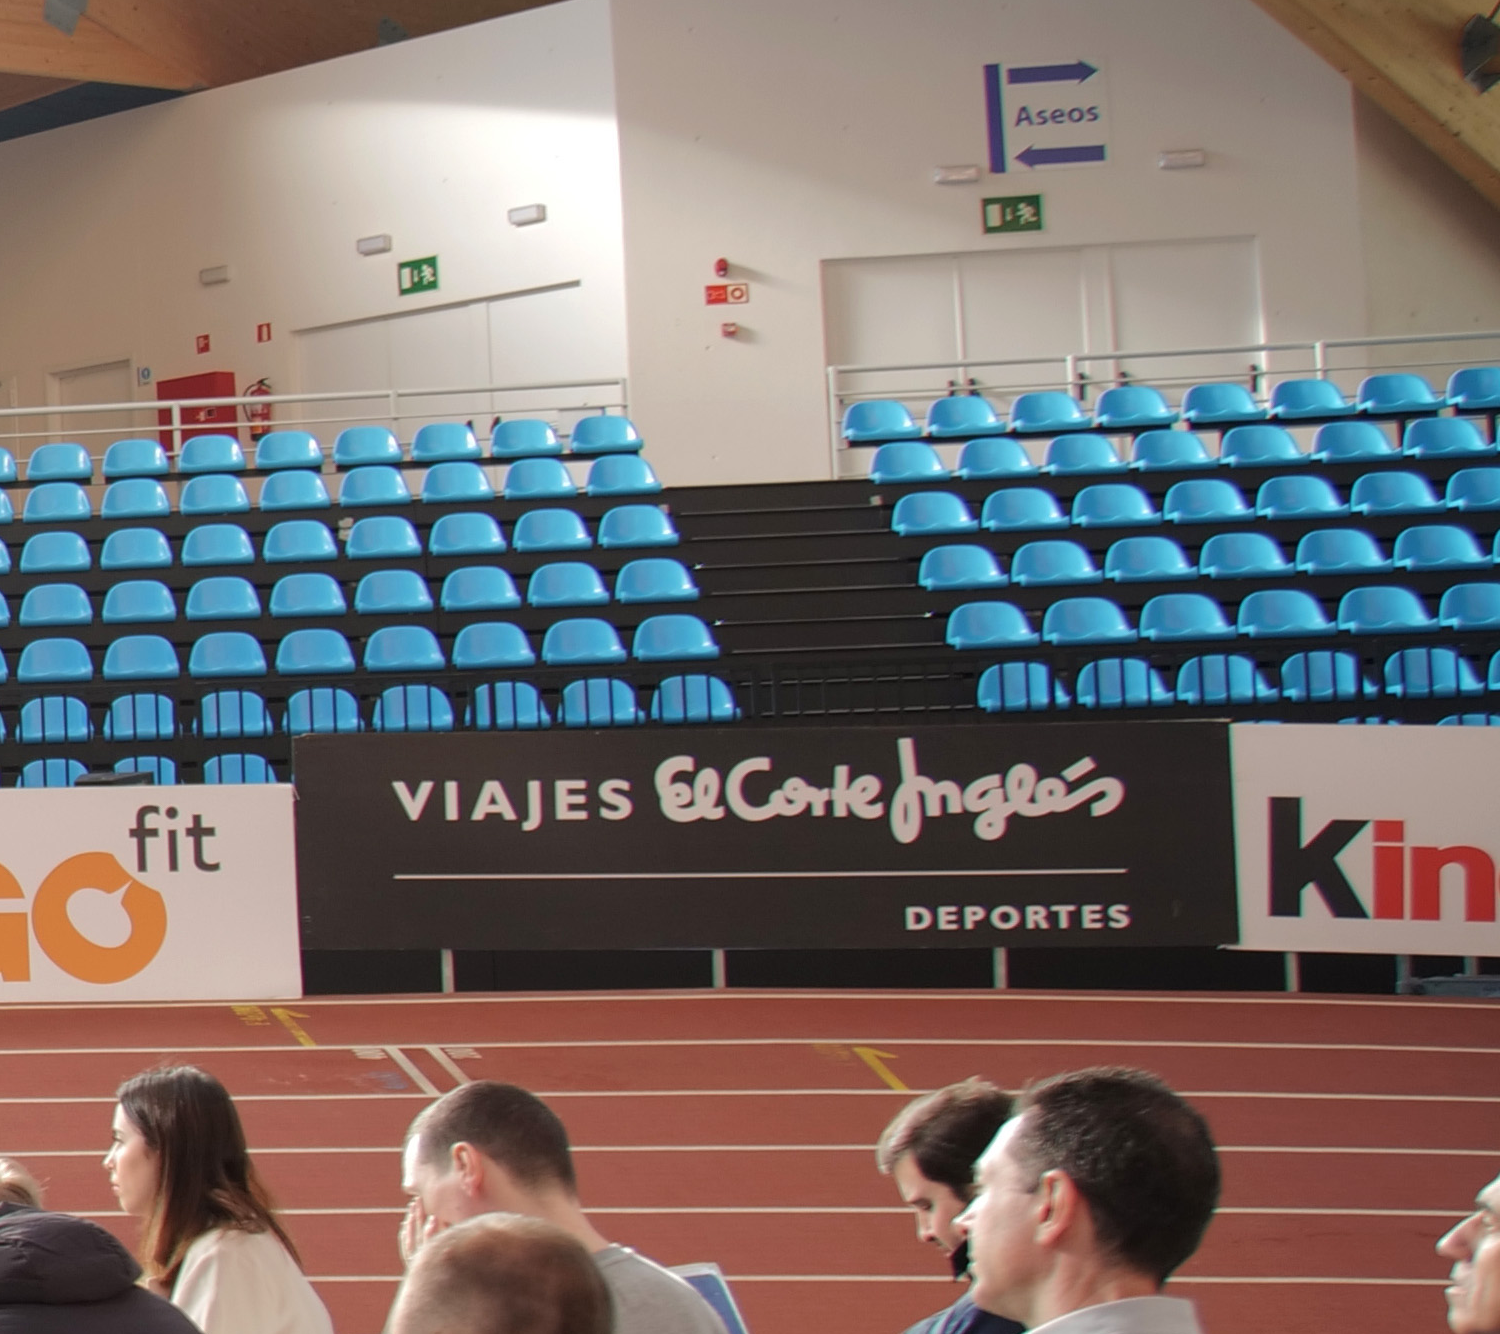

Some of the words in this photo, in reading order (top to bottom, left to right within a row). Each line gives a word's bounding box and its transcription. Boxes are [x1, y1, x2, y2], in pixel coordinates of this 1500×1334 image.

[1015, 105, 1100, 127] Aseos
[392, 780, 633, 831] VIAJES
[654, 755, 725, 822] El
[726, 756, 884, 823] Corte
[889, 737, 1125, 844] Inglés
[128, 805, 221, 873] fit
[1268, 796, 1500, 922] kin
[904, 903, 1131, 931] DEPORTES
